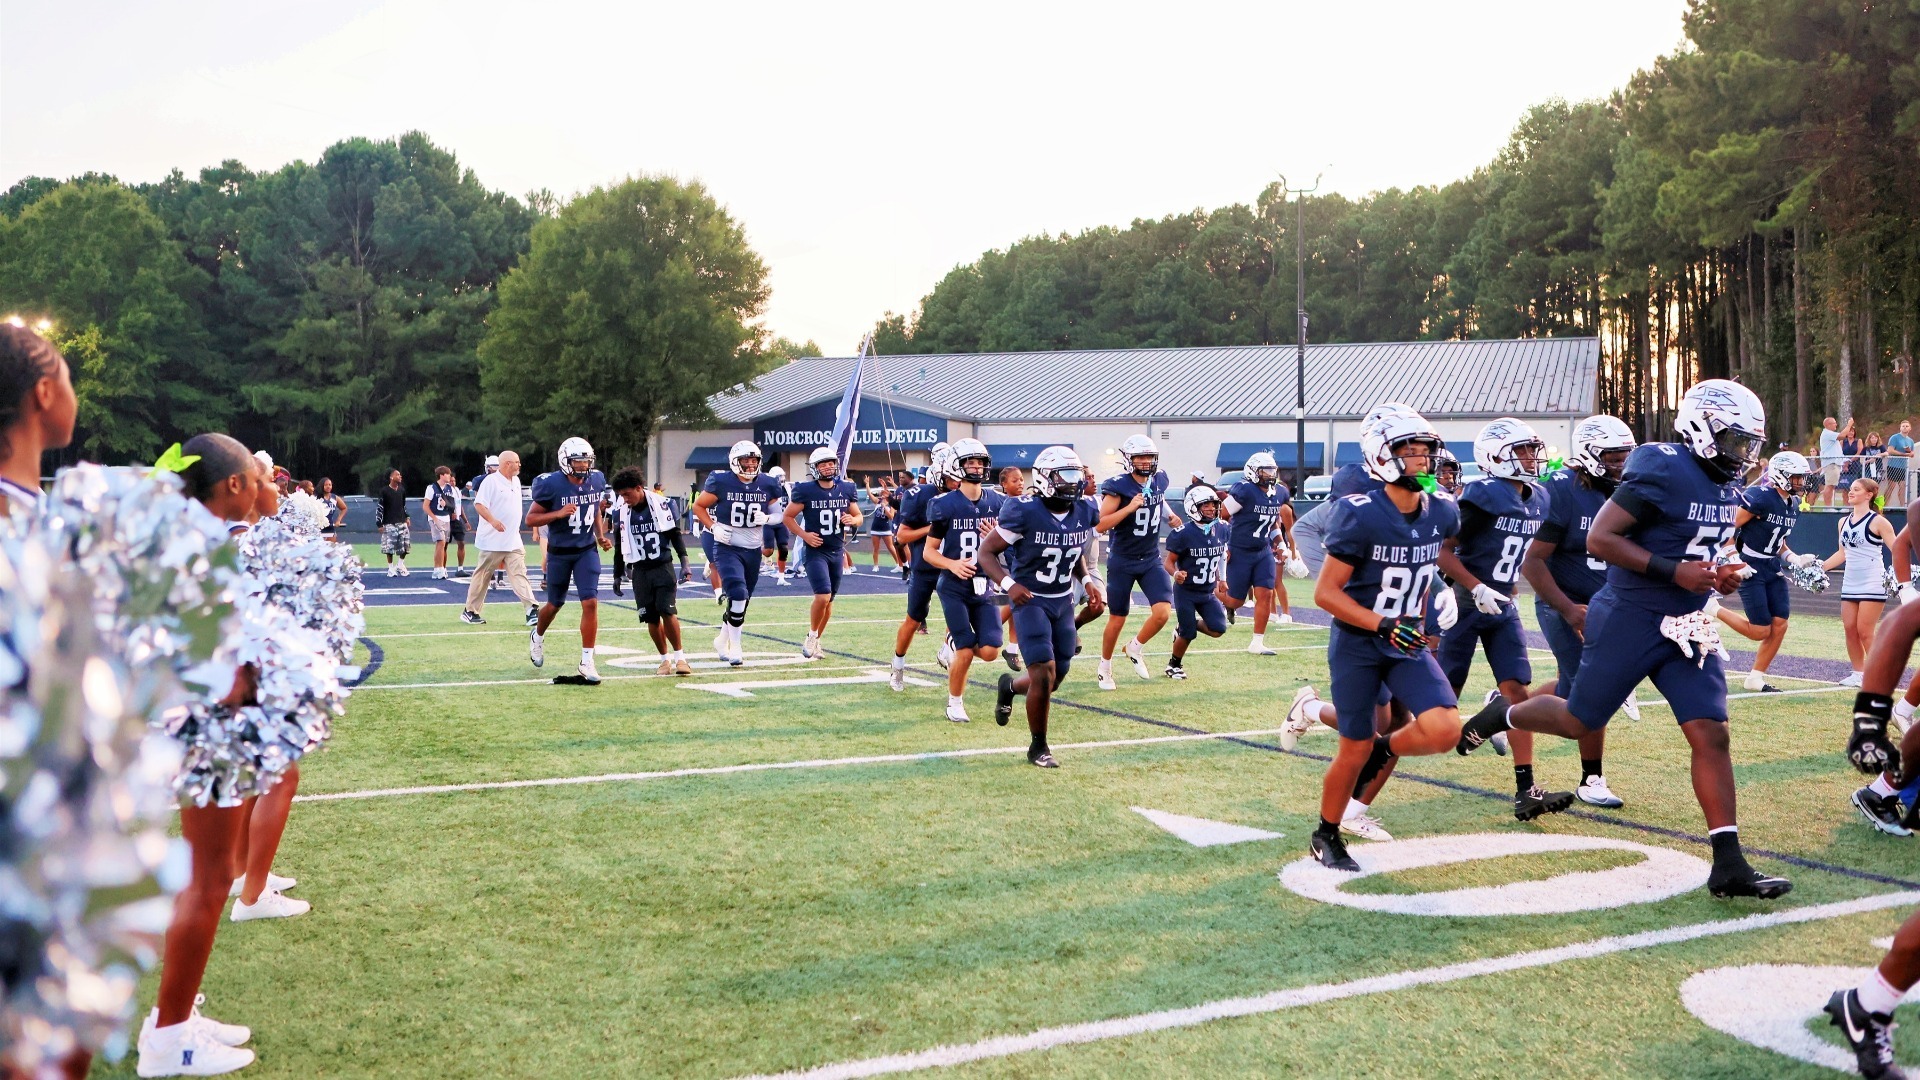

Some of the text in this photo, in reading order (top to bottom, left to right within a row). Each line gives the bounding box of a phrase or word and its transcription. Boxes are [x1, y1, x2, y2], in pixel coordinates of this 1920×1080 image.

[764, 428, 938, 445] NORCROS LUE DEVILS
[561, 491, 600, 506] BLUE DEVILS
[727, 492, 767, 502] BLUE DEVILS
[811, 499, 848, 509] BLUE DEVILS
[1254, 504, 1267, 514] BLUE
[1687, 502, 1738, 523] BLUE DEVI
[568, 503, 595, 534] 44
[819, 508, 841, 536] 91
[953, 518, 974, 530] BLUE
[1133, 504, 1161, 537] 94
[1495, 516, 1521, 534] BLUE
[1766, 513, 1784, 526] BLUE
[1034, 529, 1088, 546] BLUE DEVILS
[959, 530, 982, 567] 8
[1190, 547, 1207, 557] BLUE
[1372, 541, 1443, 564] BLUE DEVIL
[1035, 546, 1082, 584] 33
[1192, 555, 1221, 585] 38
[1372, 563, 1436, 619] 80
[182, 1050, 194, 1066] N
